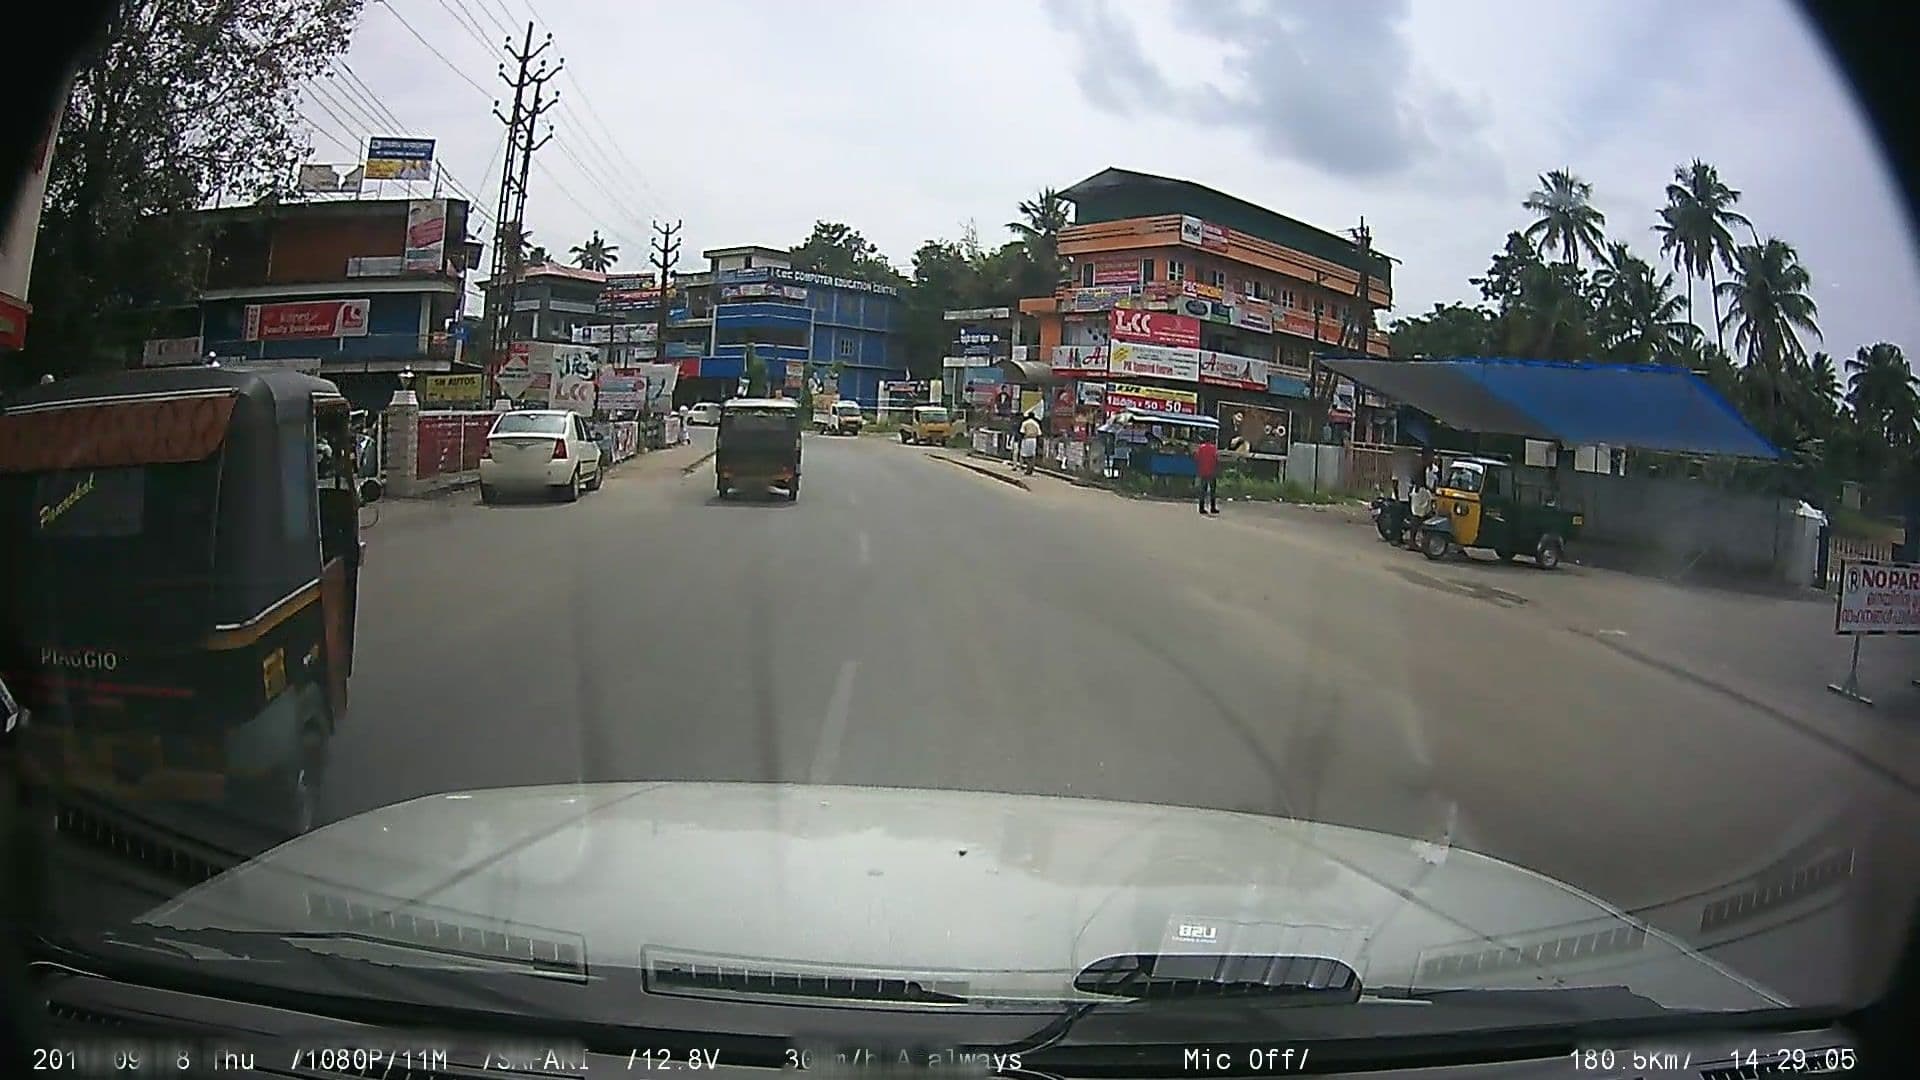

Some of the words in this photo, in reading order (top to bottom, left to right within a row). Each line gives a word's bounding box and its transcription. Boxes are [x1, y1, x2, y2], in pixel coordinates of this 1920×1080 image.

[794, 271, 834, 286] COMPUTER
[834, 278, 872, 292] EDUCATION
[1116, 310, 1152, 334] LCC
[448, 376, 476, 386] AUTOS
[1165, 400, 1182, 413] 50
[1862, 569, 1887, 588] NO
[40, 648, 118, 672] PIAGGIO
